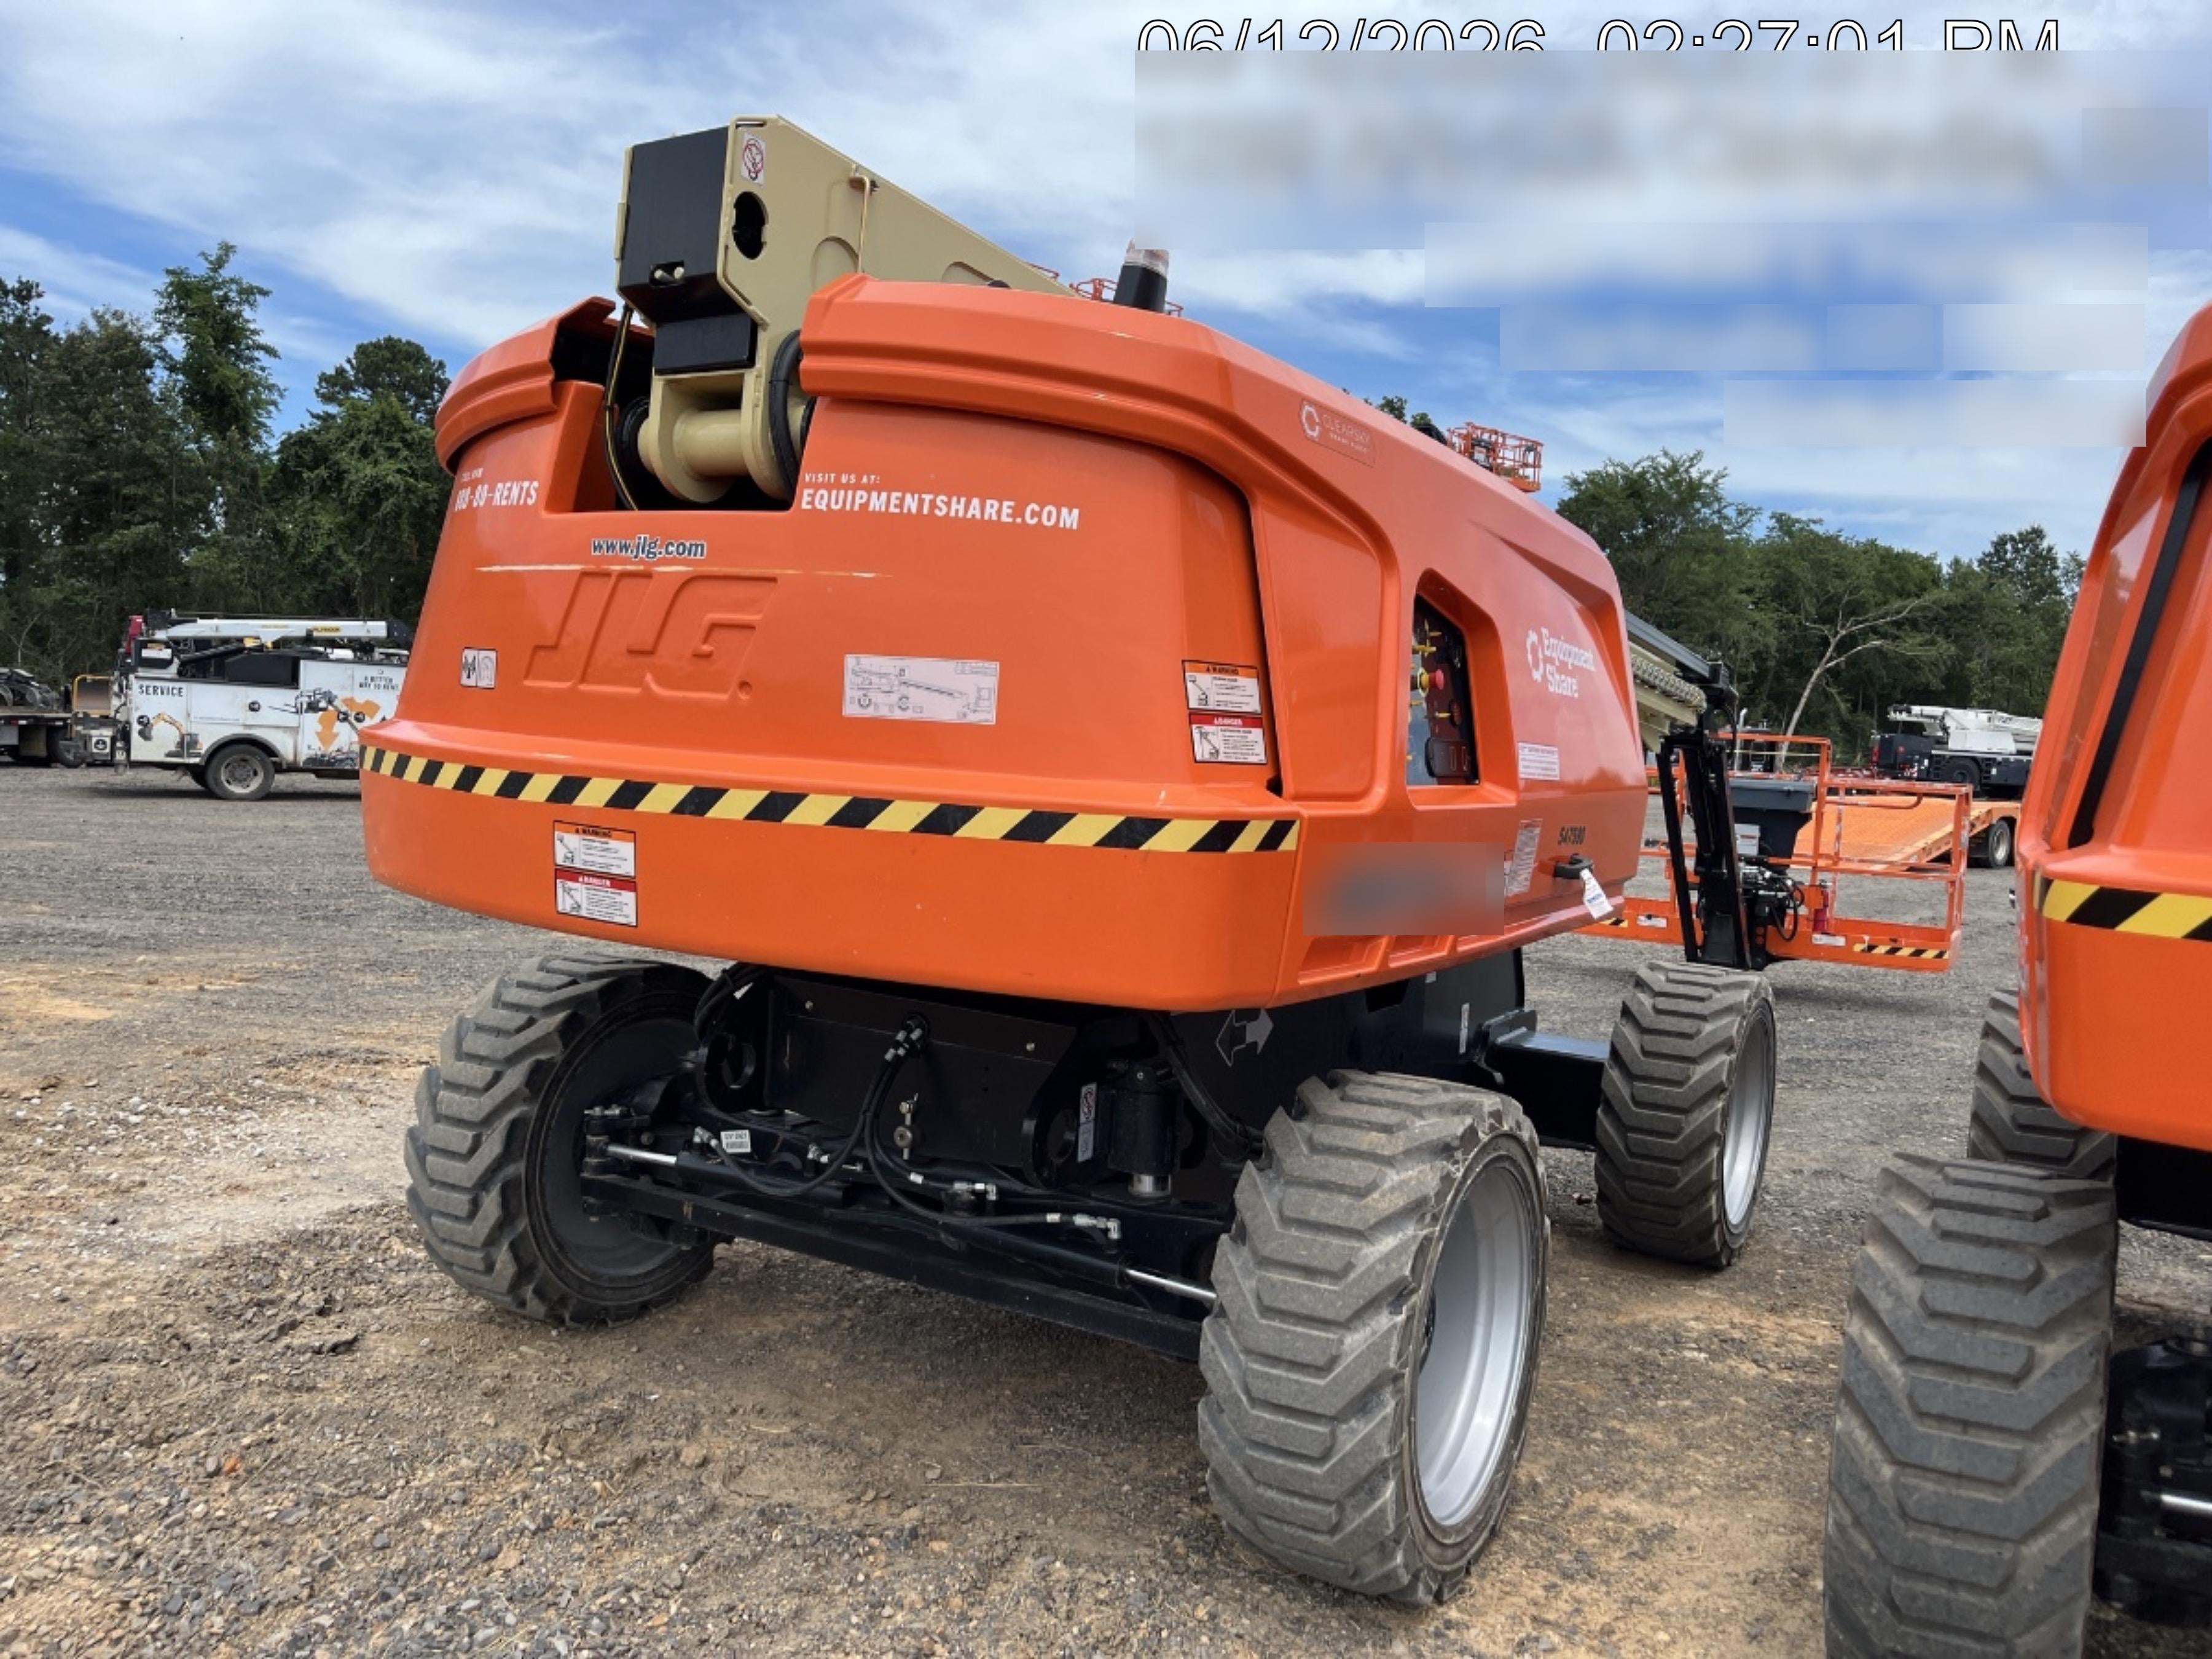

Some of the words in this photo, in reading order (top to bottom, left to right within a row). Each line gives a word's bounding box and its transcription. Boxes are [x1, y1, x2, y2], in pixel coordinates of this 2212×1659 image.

[805, 473, 836, 484] VISIT
[841, 473, 857, 484] US
[861, 474, 880, 484] AT:
[801, 487, 1080, 530] EQUIPMENTSHARE.COM
[591, 534, 707, 560] www.jlg.com
[1540, 627, 1596, 672] Equipment
[138, 683, 184, 697] SERVICE
[1545, 664, 1579, 699] Share
